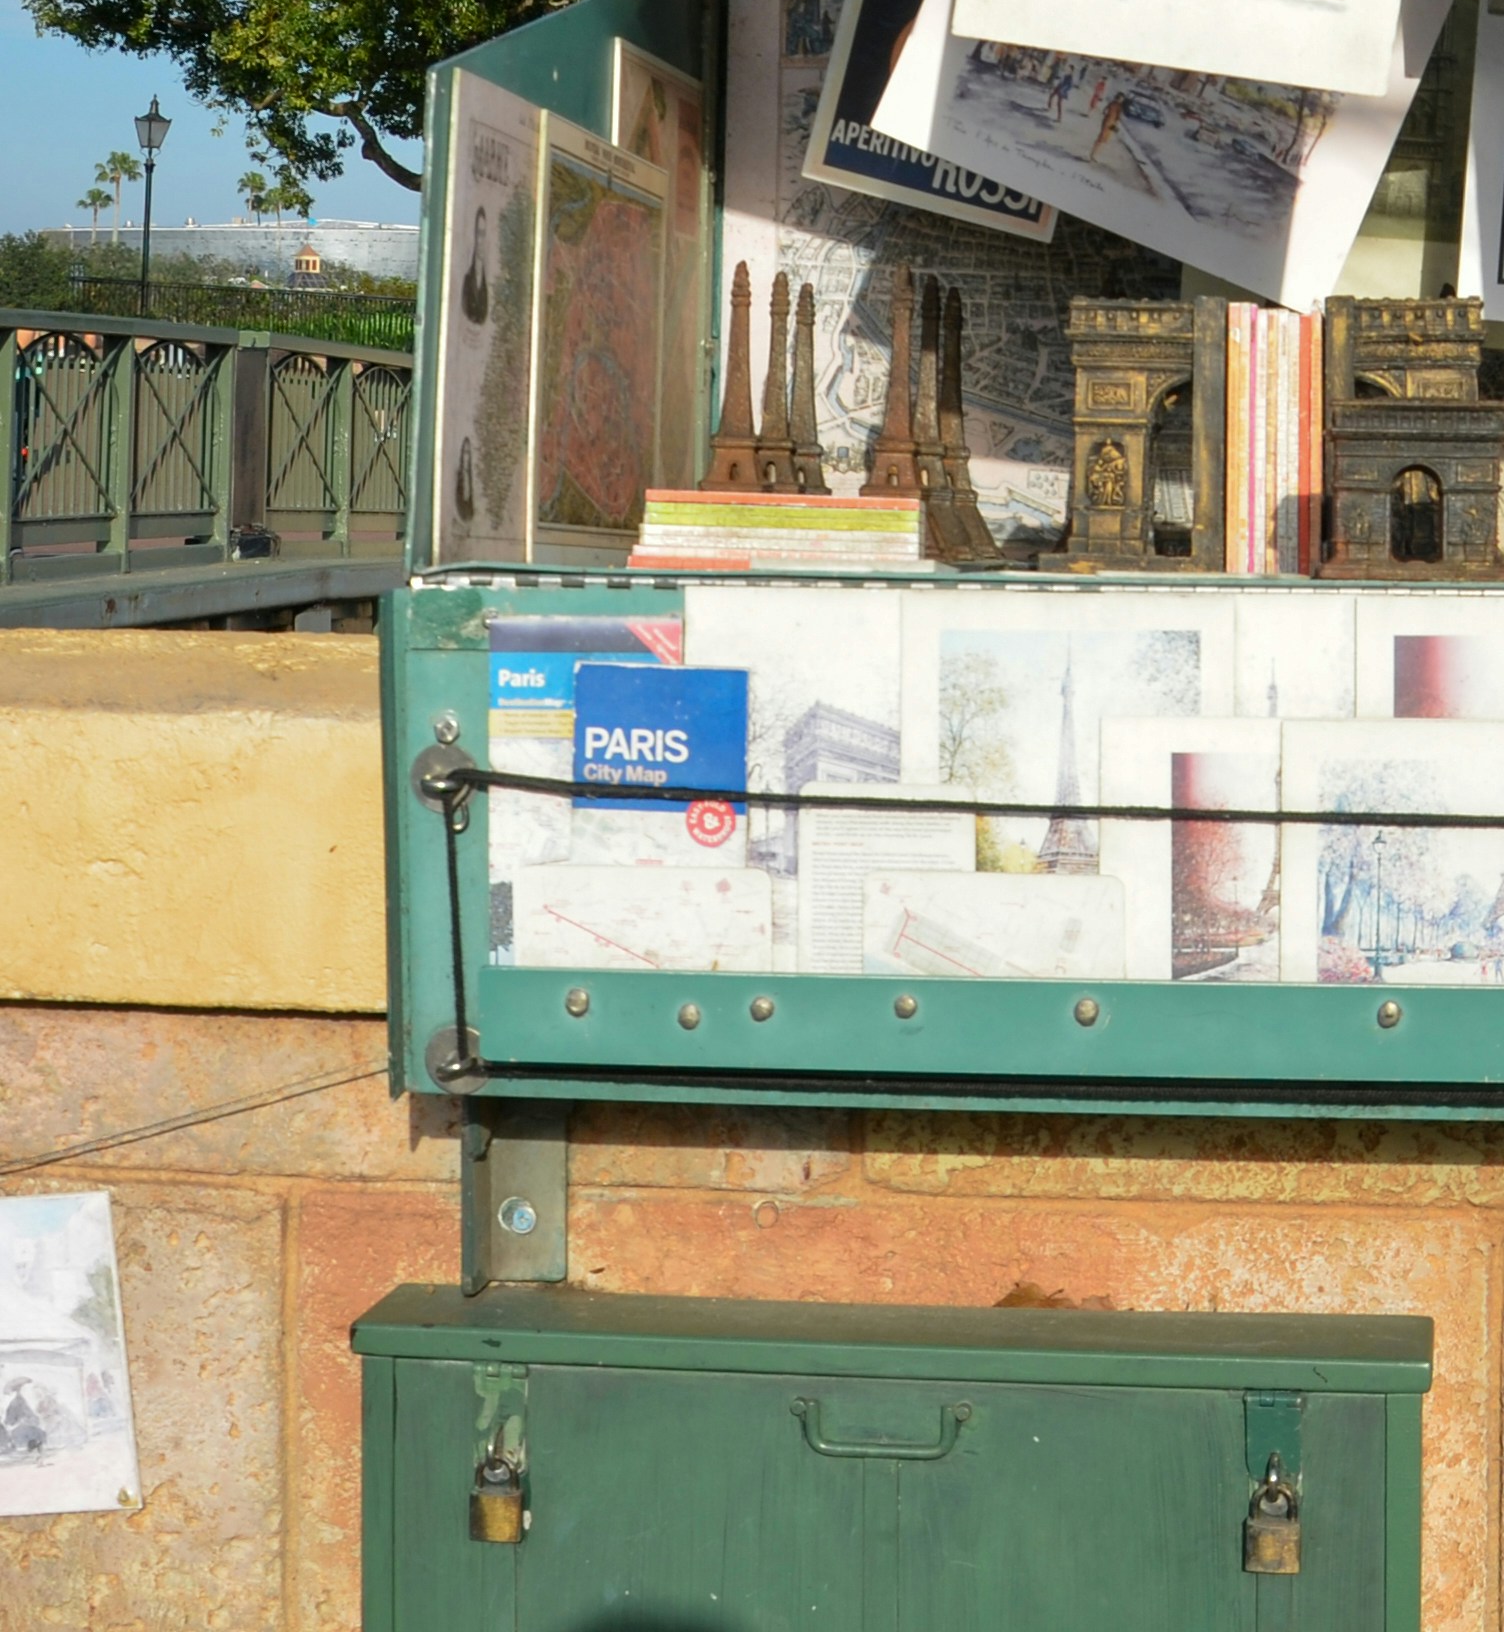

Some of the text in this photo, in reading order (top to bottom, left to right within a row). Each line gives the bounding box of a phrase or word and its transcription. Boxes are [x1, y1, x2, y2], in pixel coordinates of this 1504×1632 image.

[497, 668, 546, 688] Paris
[584, 727, 690, 763] PARIS
[582, 762, 668, 786] City Map
